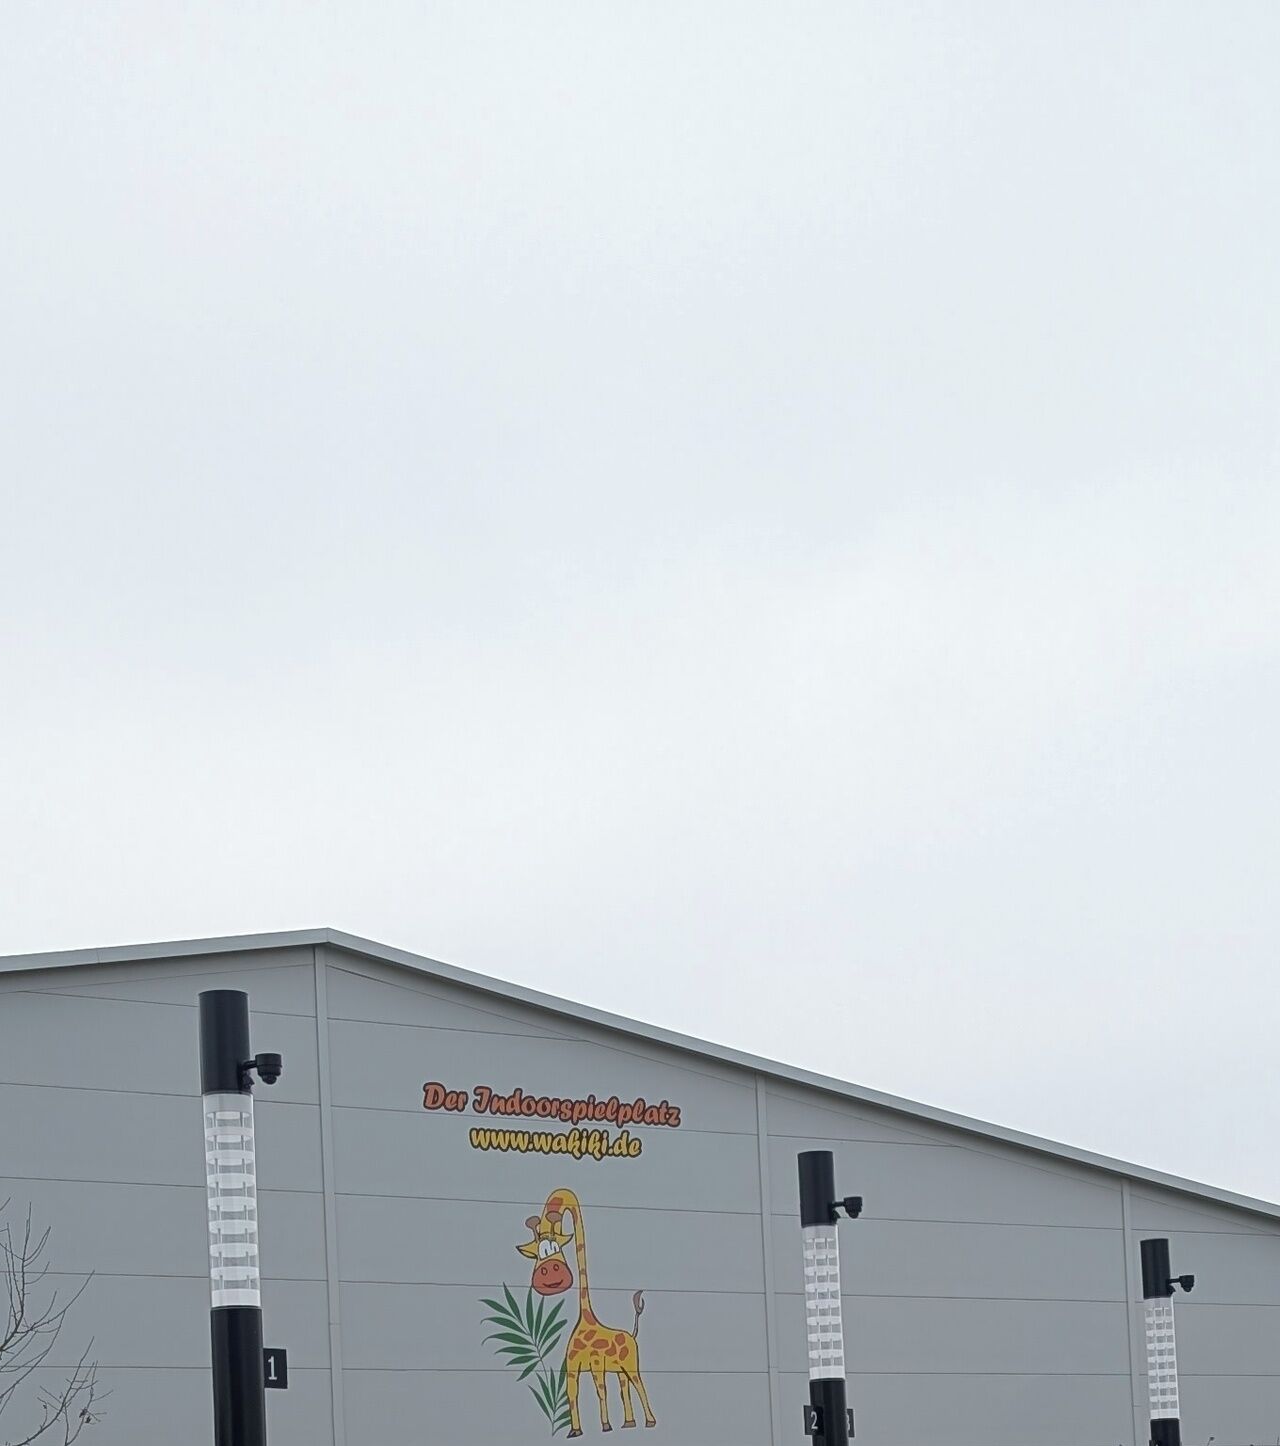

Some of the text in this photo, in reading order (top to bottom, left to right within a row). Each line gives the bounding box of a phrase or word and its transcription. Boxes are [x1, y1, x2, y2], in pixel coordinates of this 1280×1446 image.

[423, 1082, 681, 1127] Der Indoorspielplatz
[470, 1127, 642, 1160] www.wakiki.de
[268, 1356, 277, 1380] 1
[810, 1411, 818, 1429] 2
